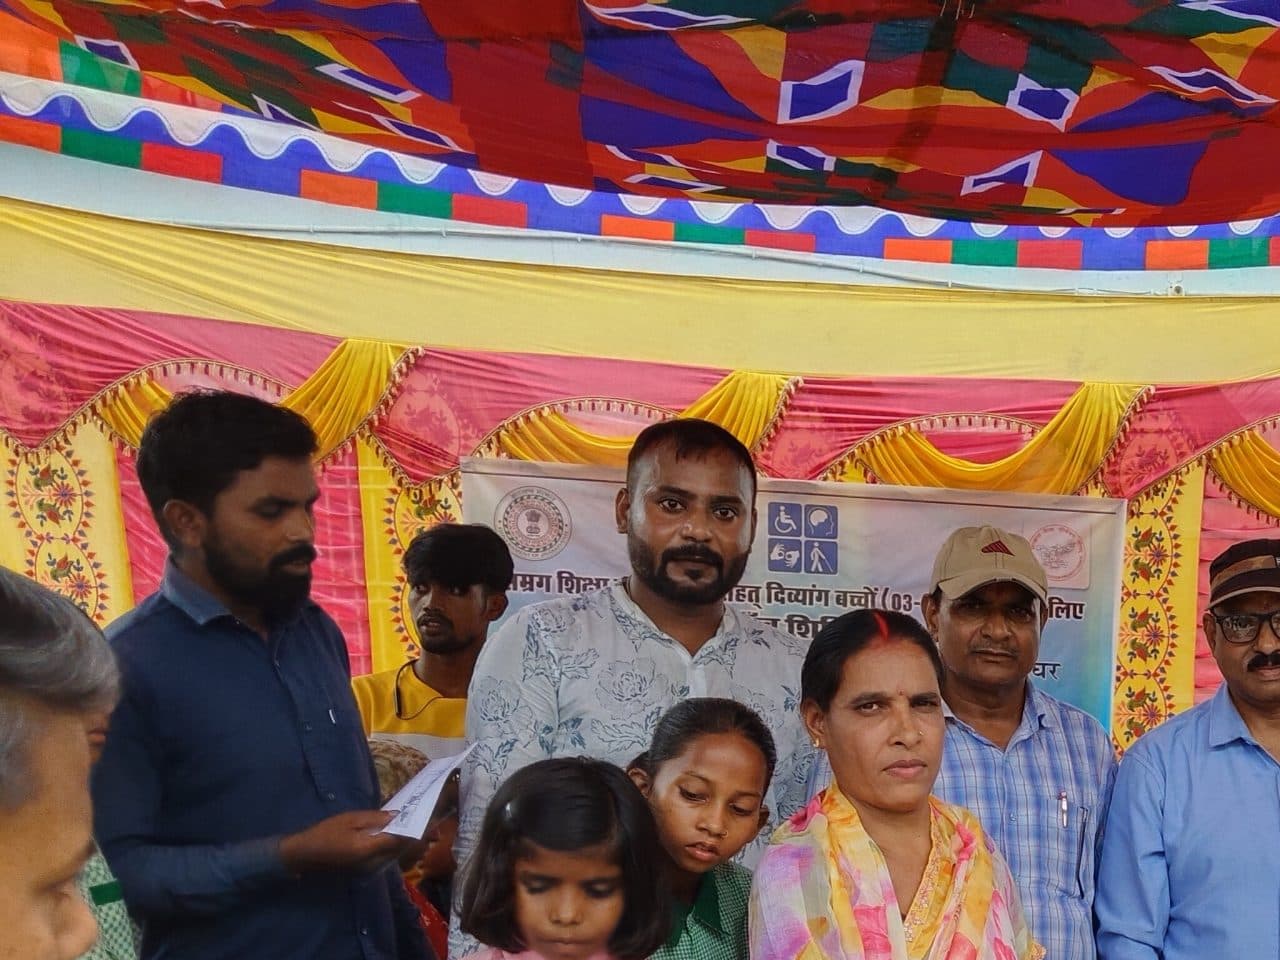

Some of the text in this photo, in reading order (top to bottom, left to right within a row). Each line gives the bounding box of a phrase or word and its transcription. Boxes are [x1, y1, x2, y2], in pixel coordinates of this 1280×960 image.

[766, 581, 831, 606] दिव्यांग
[834, 585, 878, 609] बच्चों
[881, 587, 922, 612] (03-
